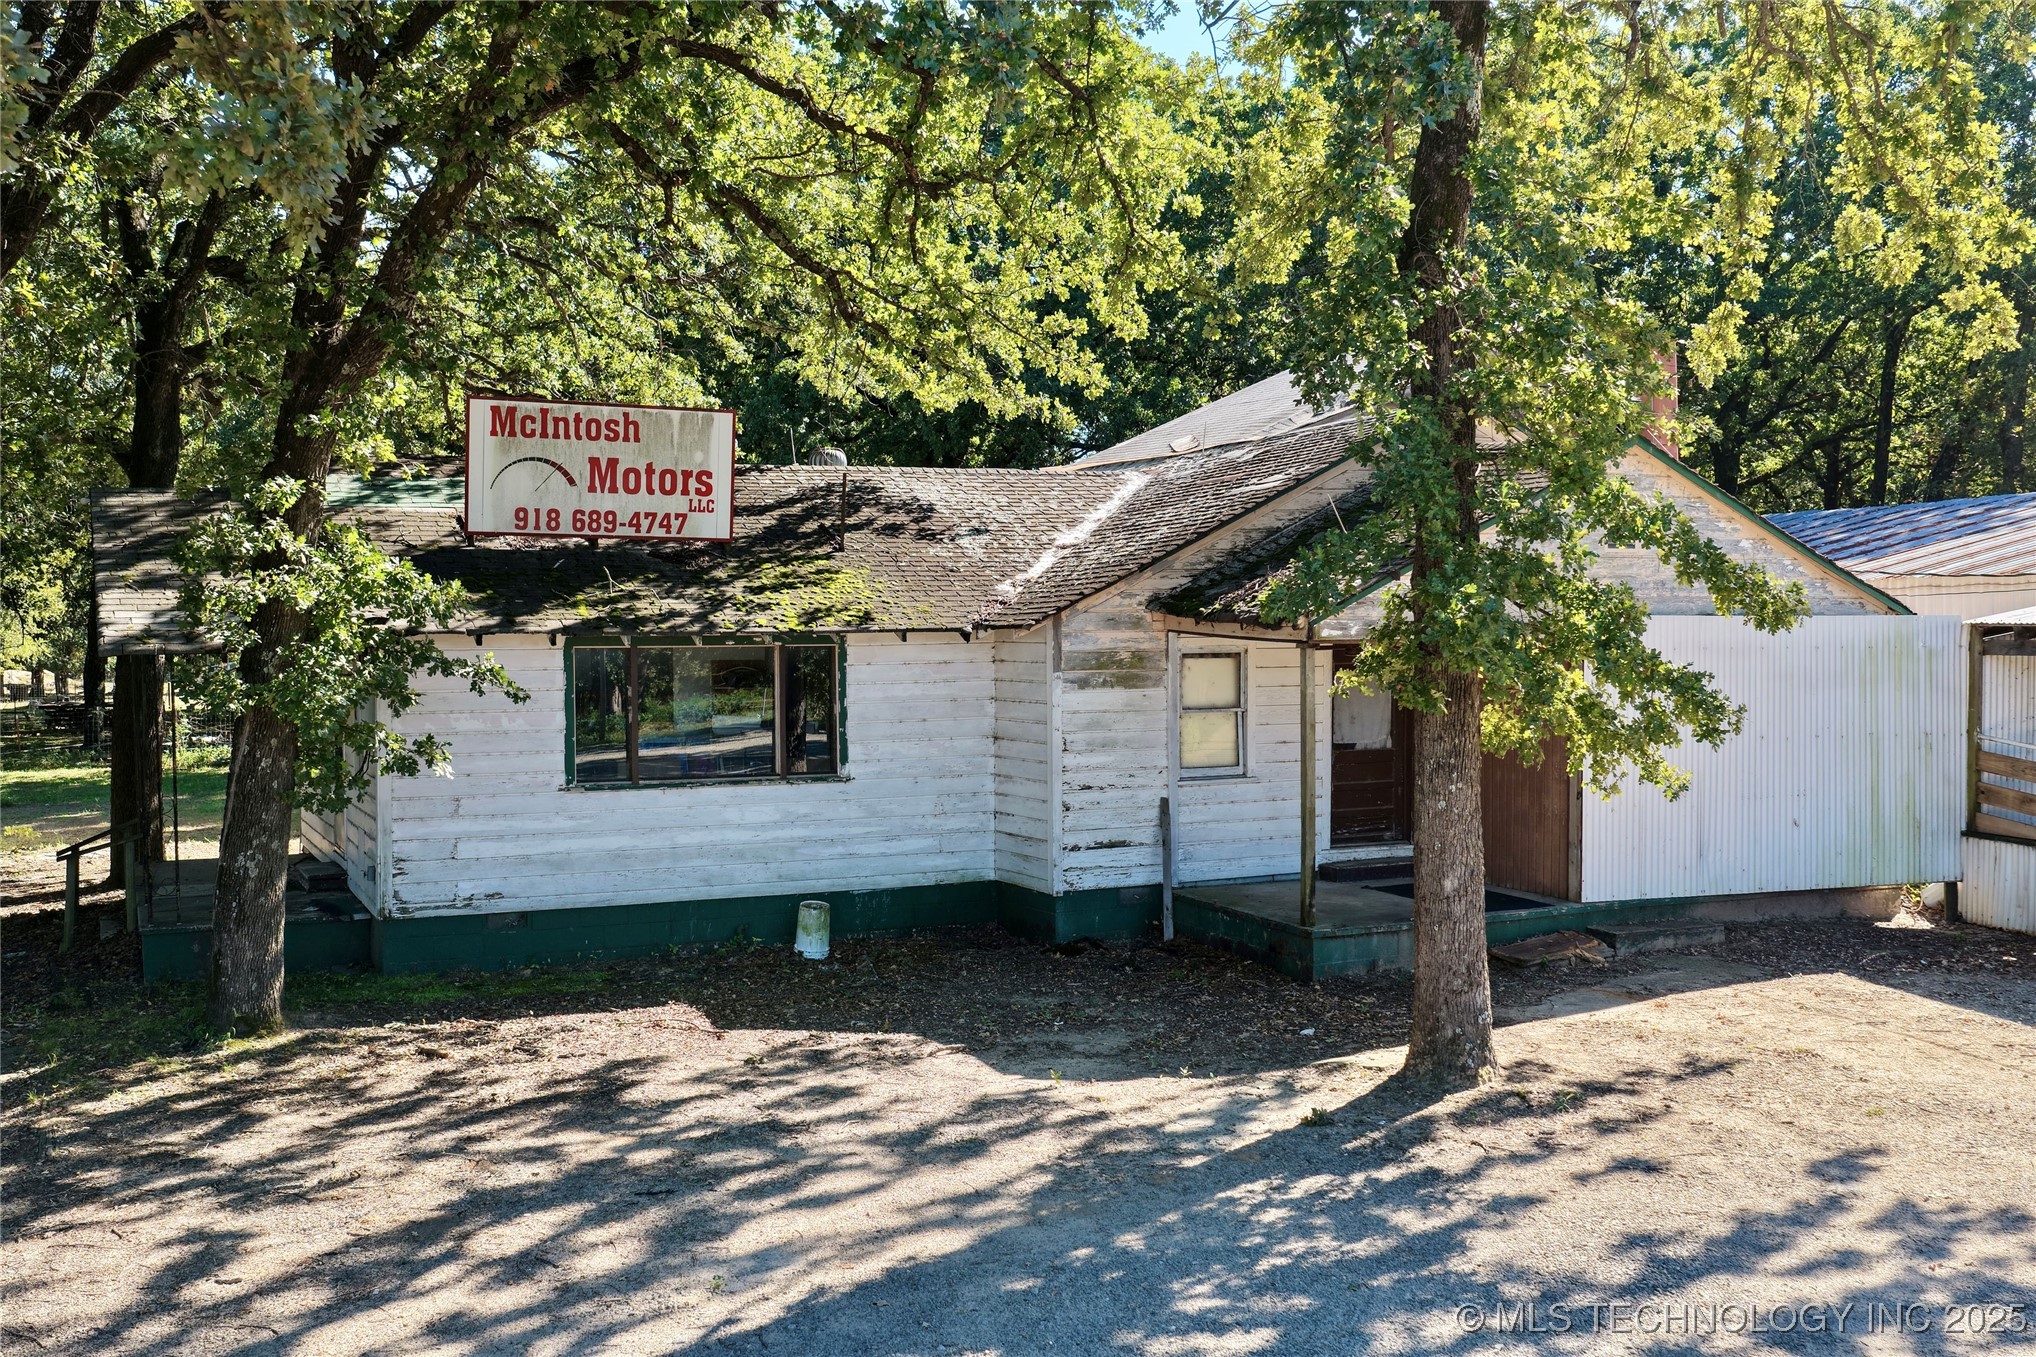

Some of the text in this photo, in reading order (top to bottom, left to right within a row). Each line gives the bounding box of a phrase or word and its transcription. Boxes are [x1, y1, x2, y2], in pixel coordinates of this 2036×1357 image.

[490, 405, 640, 442] McIntosh
[587, 457, 713, 497] Motors
[514, 507, 688, 534] 918 689-4747
[688, 499, 714, 513] LLC
